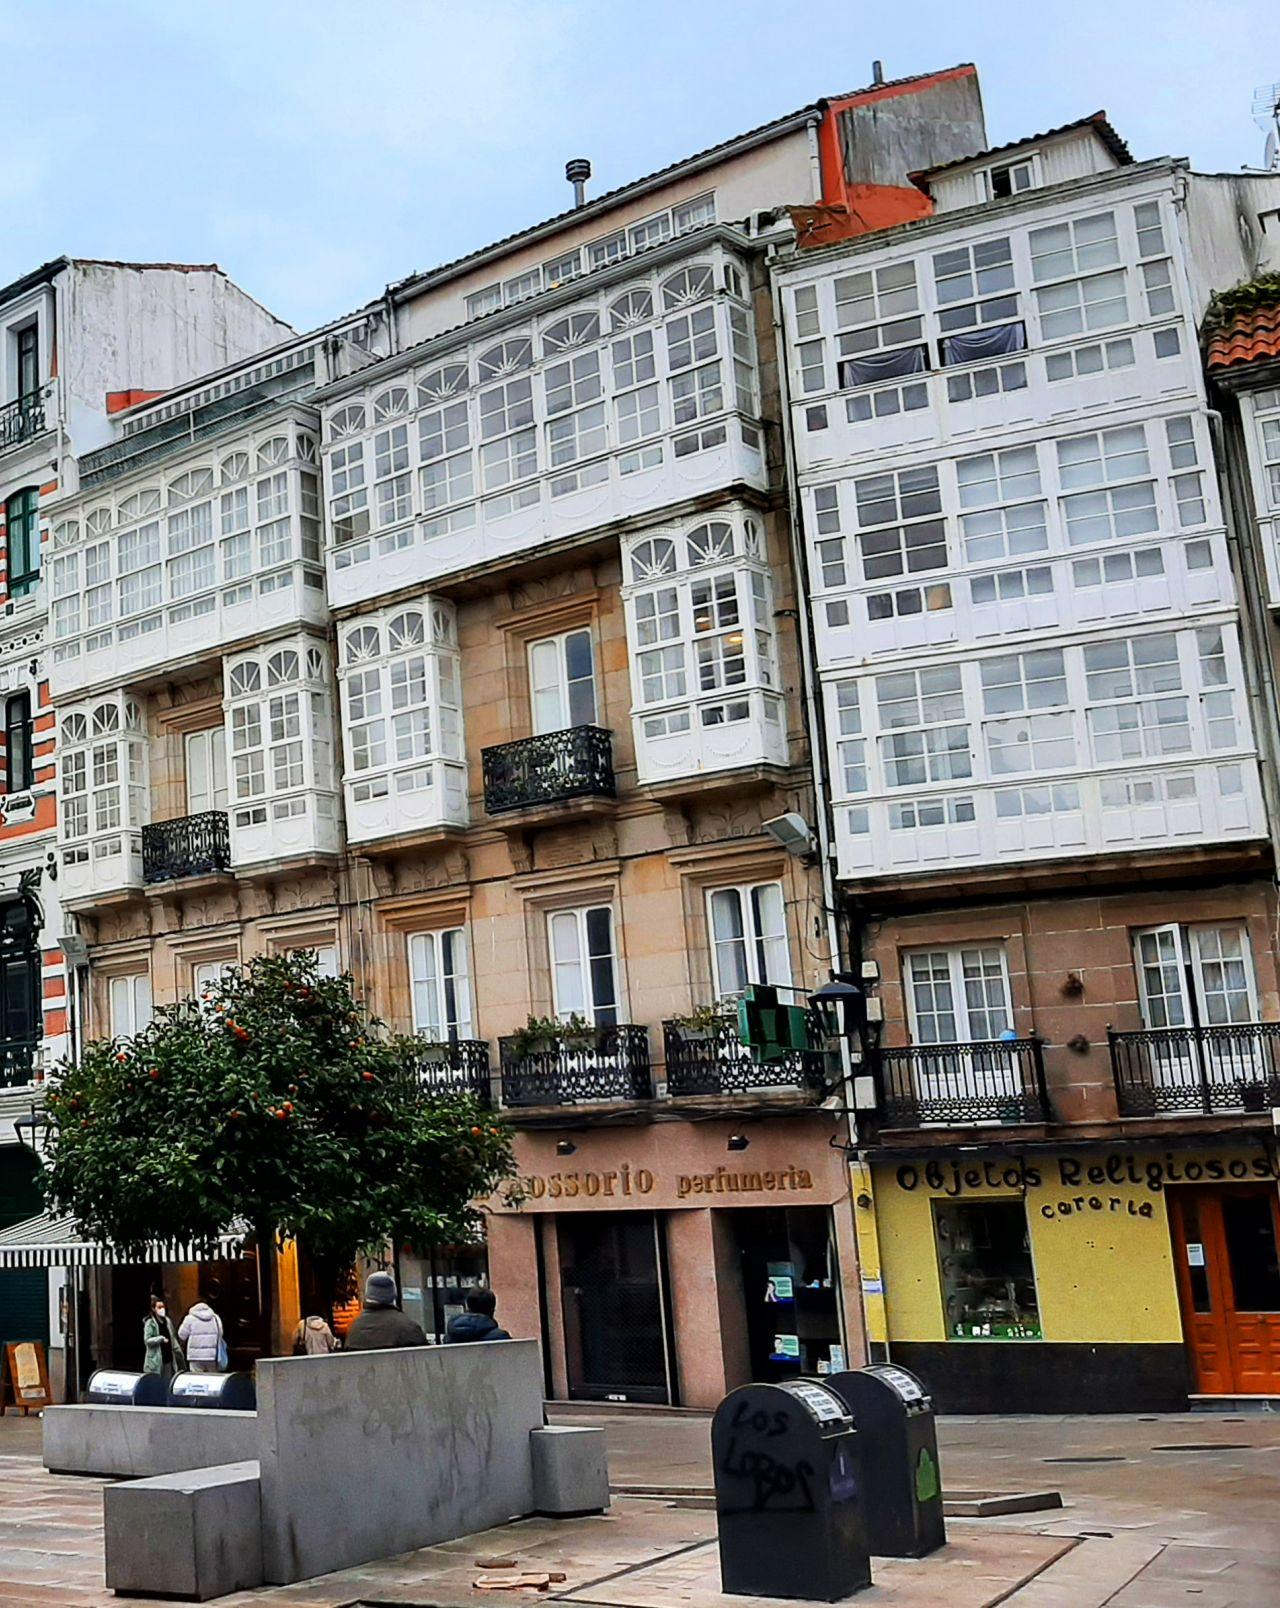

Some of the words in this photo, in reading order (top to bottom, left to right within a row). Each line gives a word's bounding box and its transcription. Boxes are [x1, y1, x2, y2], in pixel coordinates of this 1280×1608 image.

[529, 1163, 654, 1199] ossorio
[676, 1164, 814, 1199] perfumeria
[896, 1160, 1042, 1196] Objetos
[1058, 1153, 1271, 1192] Religiosos
